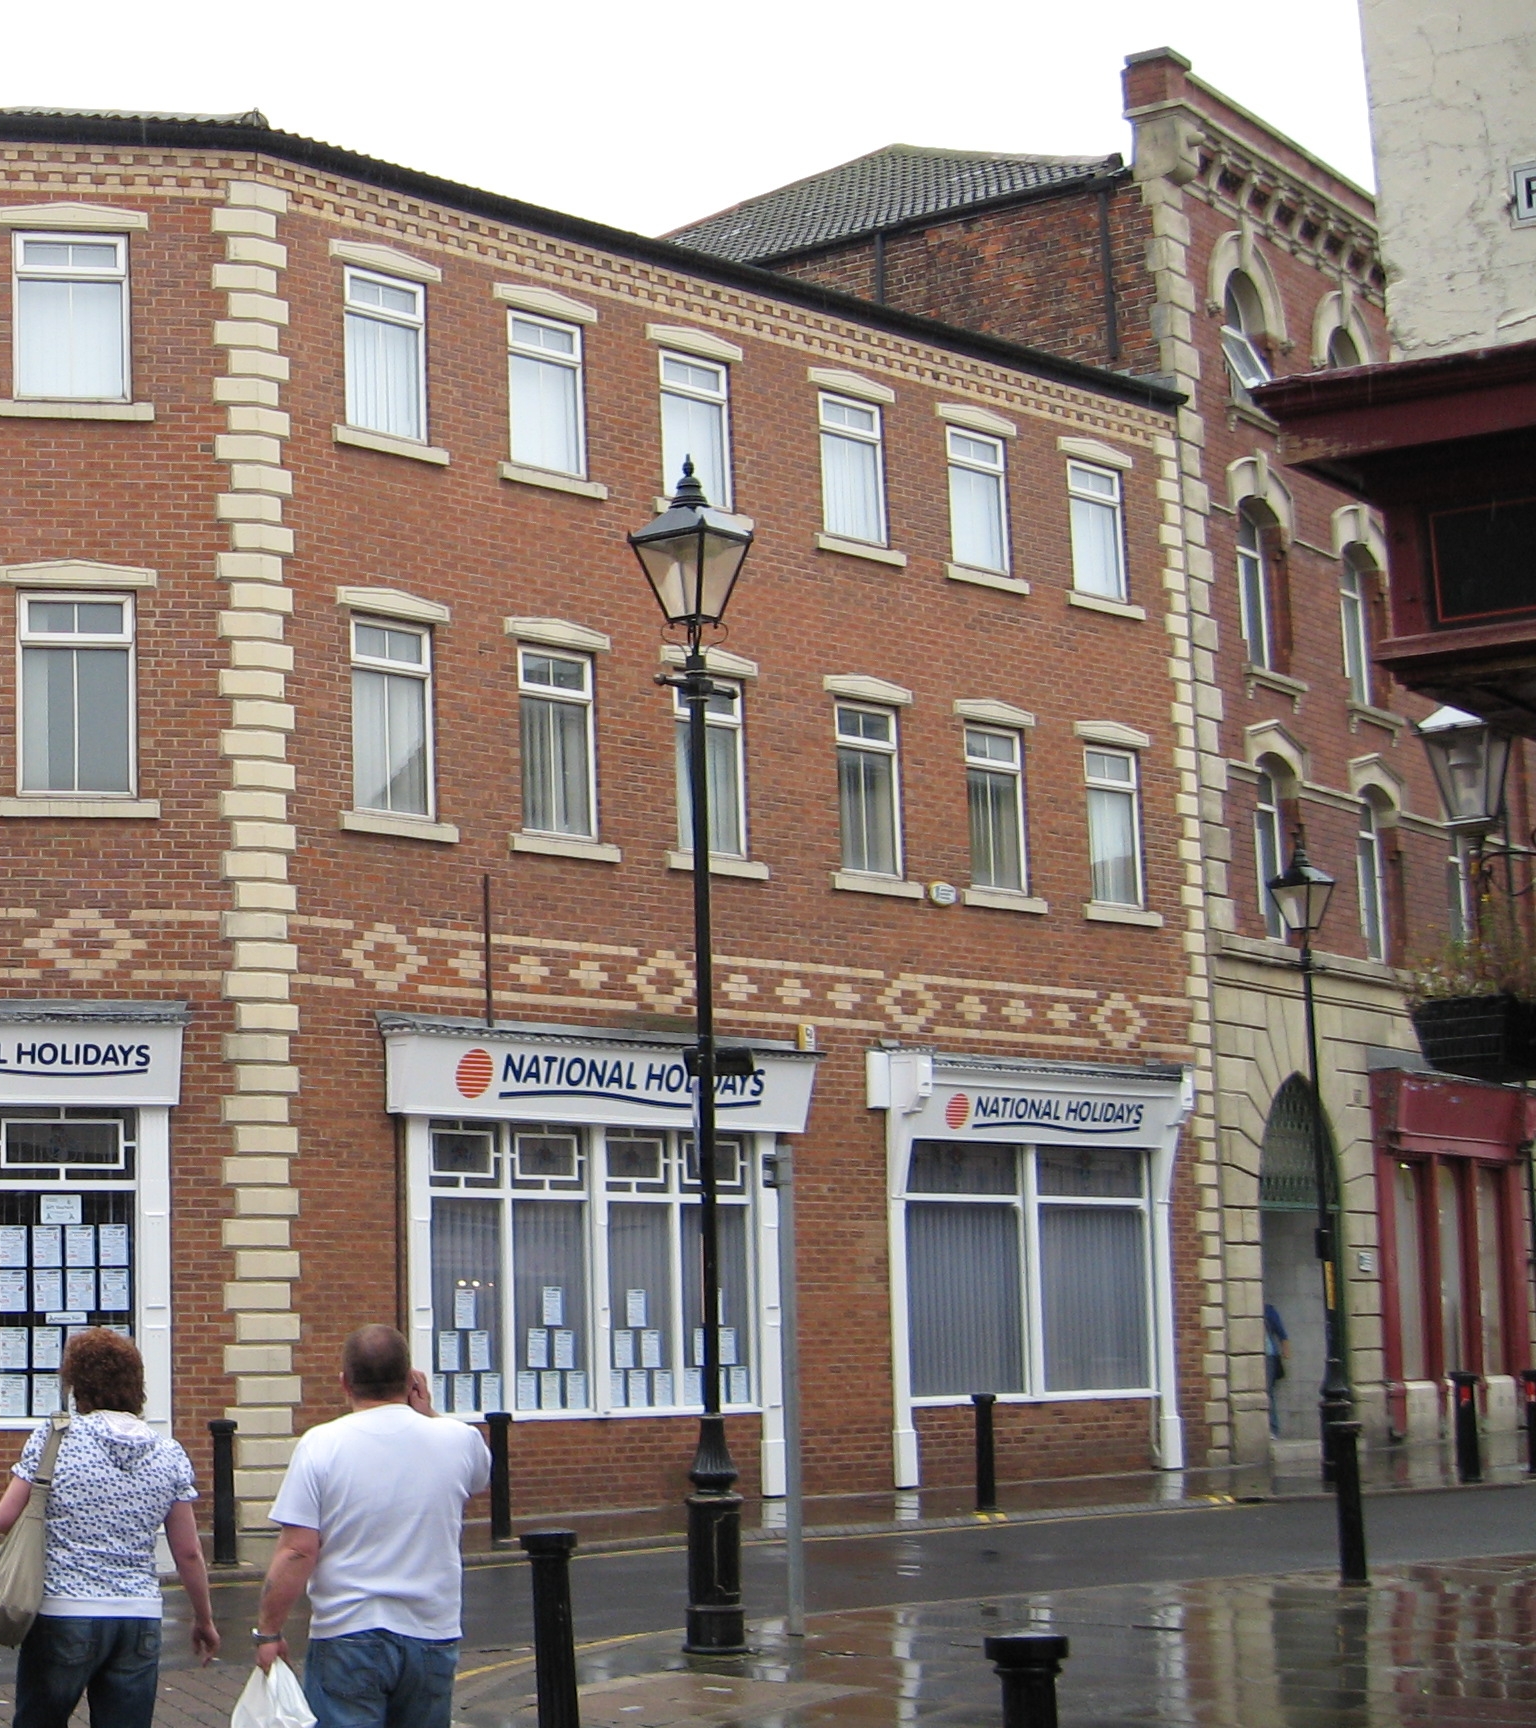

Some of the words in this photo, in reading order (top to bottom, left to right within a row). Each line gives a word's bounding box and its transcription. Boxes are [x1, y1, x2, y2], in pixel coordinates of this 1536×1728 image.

[17, 1042, 151, 1067] HOLIDAYS
[502, 1053, 638, 1090] NATIONAL
[645, 1062, 766, 1097] HOLAYS
[975, 1096, 1062, 1120] NATIONAL
[1065, 1100, 1145, 1124] HOLIDAYS
